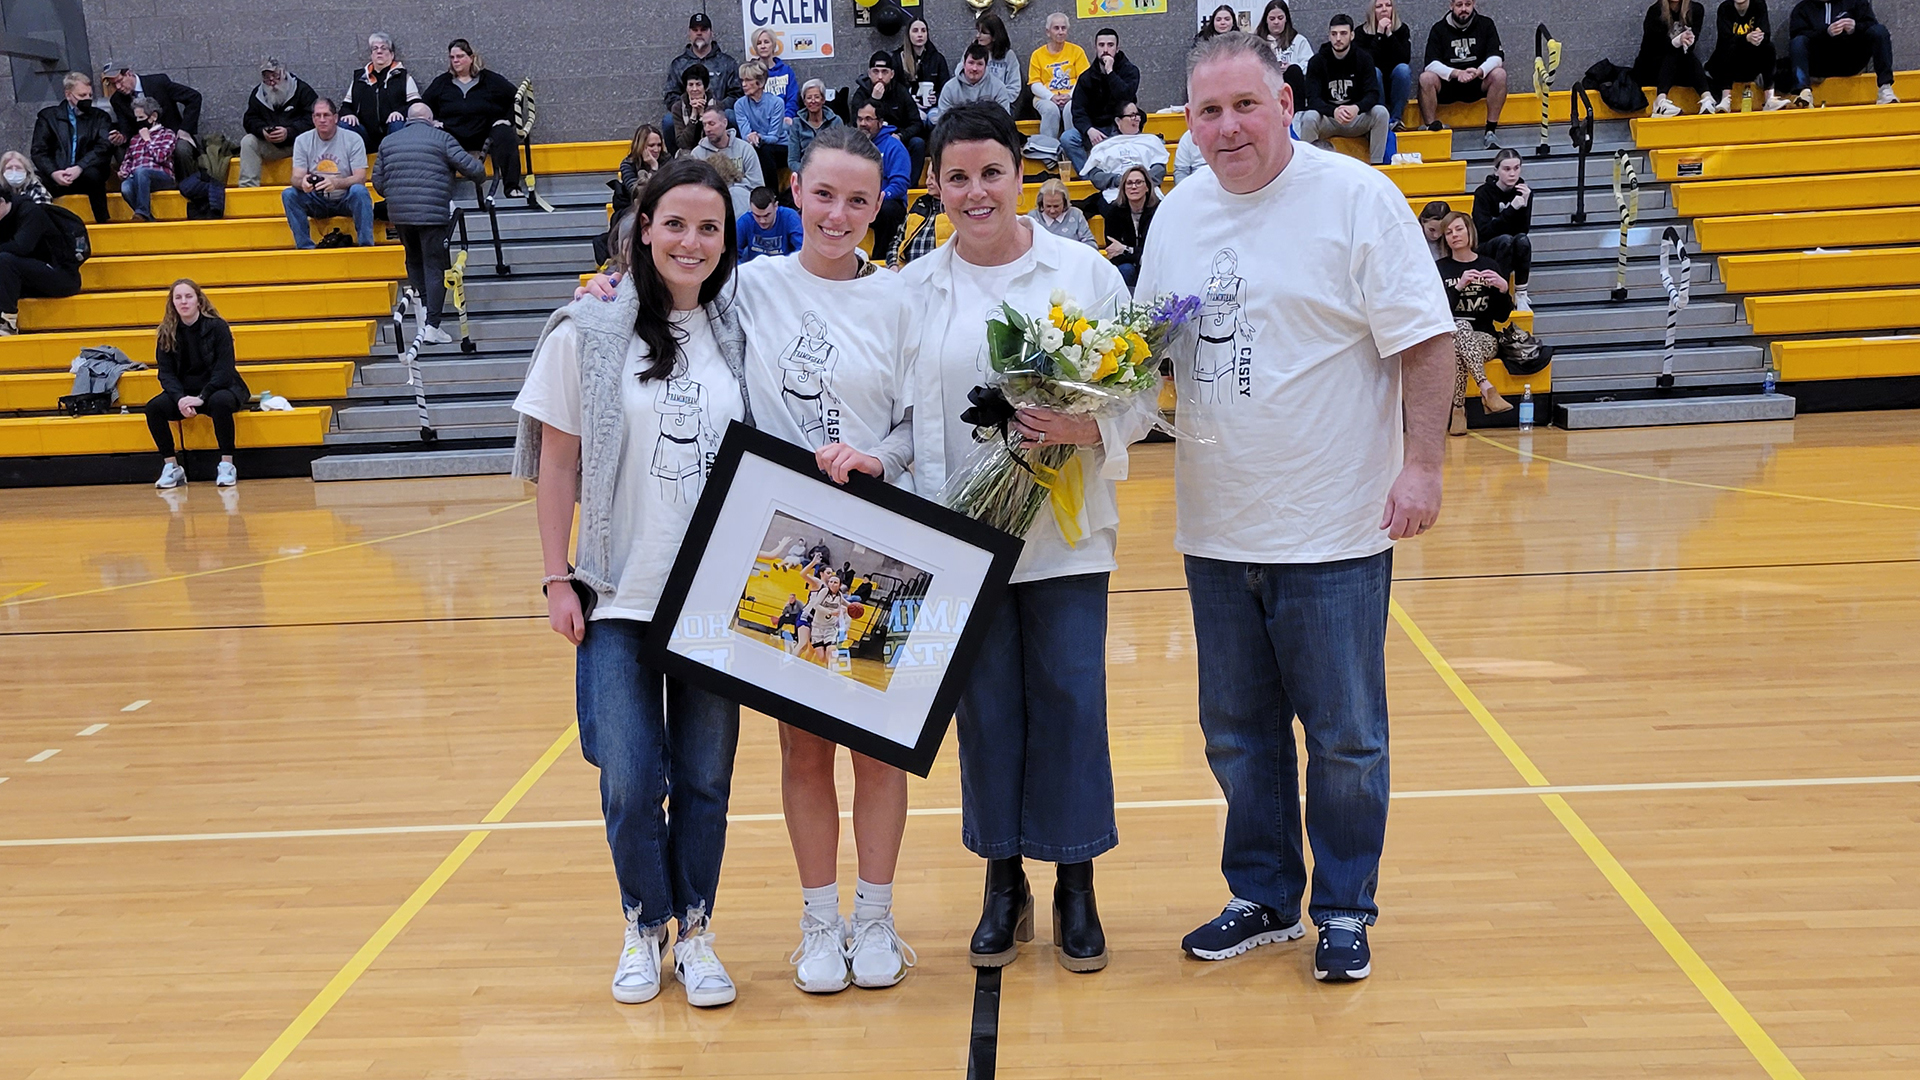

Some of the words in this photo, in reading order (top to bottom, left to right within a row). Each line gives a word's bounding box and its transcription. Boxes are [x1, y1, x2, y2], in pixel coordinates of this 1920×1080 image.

[750, 0, 828, 26] CALEN
[1455, 296, 1489, 312] AMS
[1239, 347, 1252, 398] CASEY
[827, 409, 840, 444] CASE
